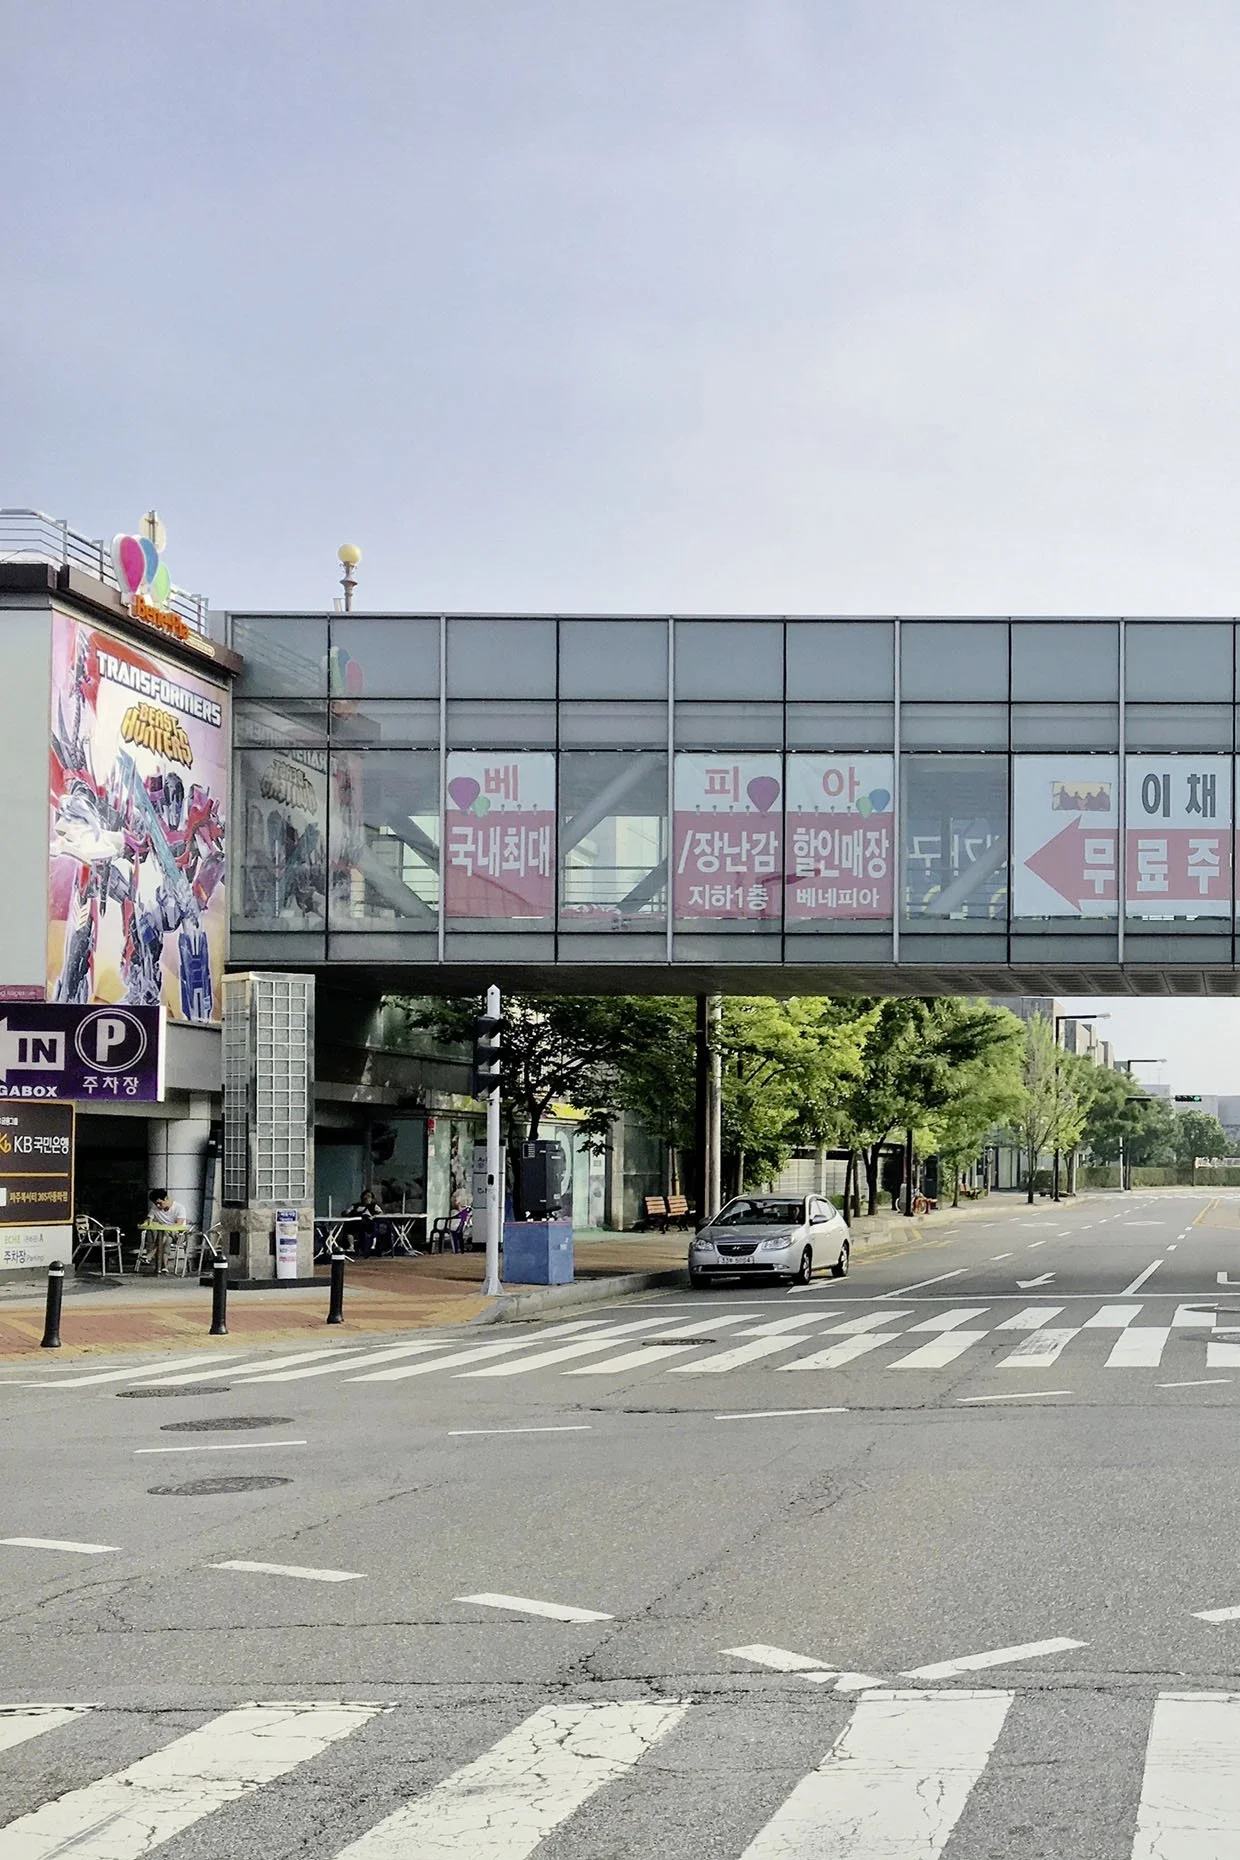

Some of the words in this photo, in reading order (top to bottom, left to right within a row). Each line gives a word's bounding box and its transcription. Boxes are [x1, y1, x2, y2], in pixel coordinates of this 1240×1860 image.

[96, 650, 222, 729] TRANSFORMERS
[121, 706, 193, 770] HUNTERS
[138, 702, 180, 736] BEAST
[484, 764, 519, 802] 베
[704, 766, 740, 803] 피
[822, 766, 861, 803] 아
[448, 826, 551, 877] 국내최대
[793, 828, 889, 878] 할인매장
[688, 884, 769, 911] 지하1층
[796, 886, 880, 909] 베네피아
[18, 1038, 58, 1063] IN
[95, 1018, 126, 1062] P
[82, 1076, 140, 1096] 주차장
[4, 1250, 26, 1264] 주차장
